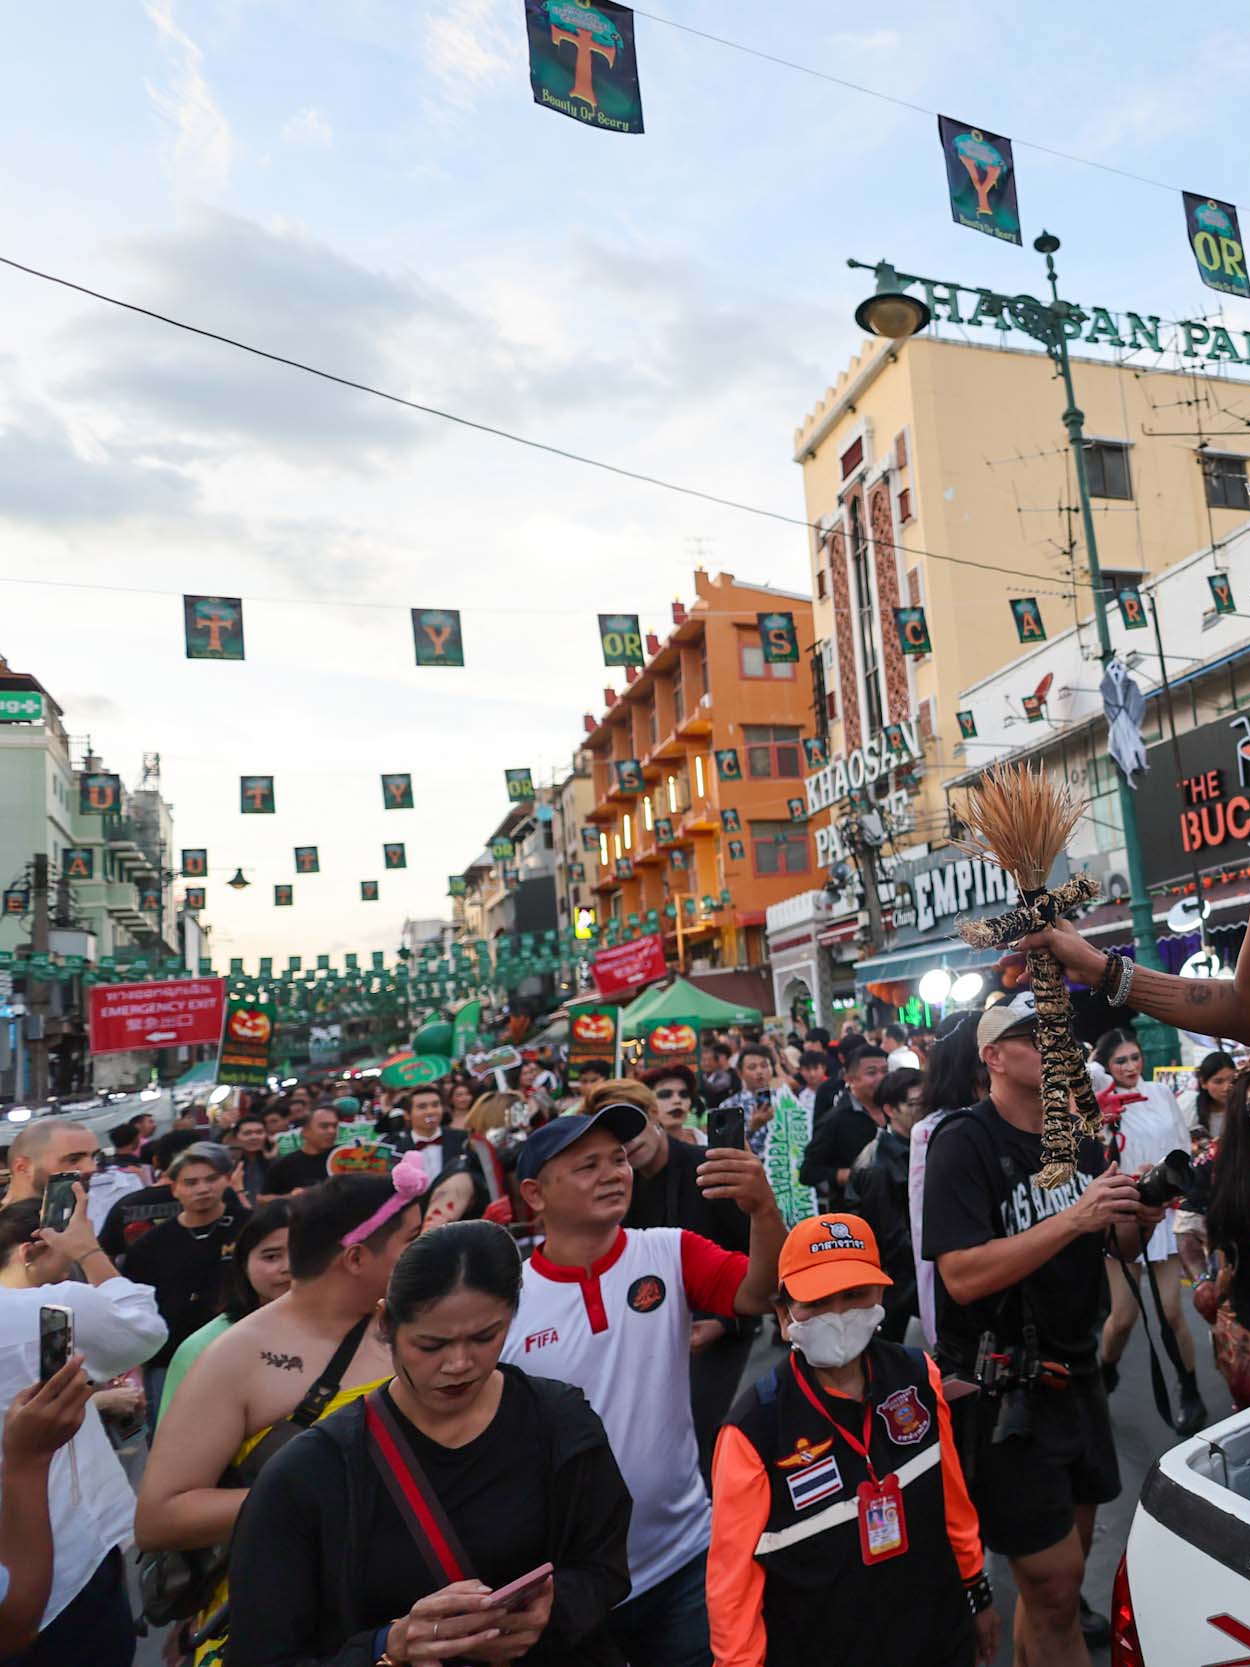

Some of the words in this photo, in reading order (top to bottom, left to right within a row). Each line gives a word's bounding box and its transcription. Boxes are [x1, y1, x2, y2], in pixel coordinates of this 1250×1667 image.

[550, 24, 617, 116] T
[958, 154, 1001, 218] Y
[1193, 231, 1247, 279] OR
[1216, 586, 1229, 606] Y
[1023, 611, 1041, 636] A
[1125, 599, 1142, 623] R
[195, 614, 234, 656] T
[422, 626, 452, 656] Y
[603, 633, 641, 657] OR
[768, 628, 792, 656] S
[904, 620, 926, 645] C
[722, 758, 737, 776] C
[507, 781, 535, 797] OR
[624, 771, 638, 789] S
[88, 785, 115, 810] U
[245, 786, 270, 809] T
[388, 783, 408, 804] Y
[69, 857, 88, 876] A
[100, 1000, 186, 1018] EMERGENCY
[187, 997, 218, 1010] EXIT
[767, 1135, 791, 1196] HAPPY
[525, 1327, 559, 1354] FIFA
